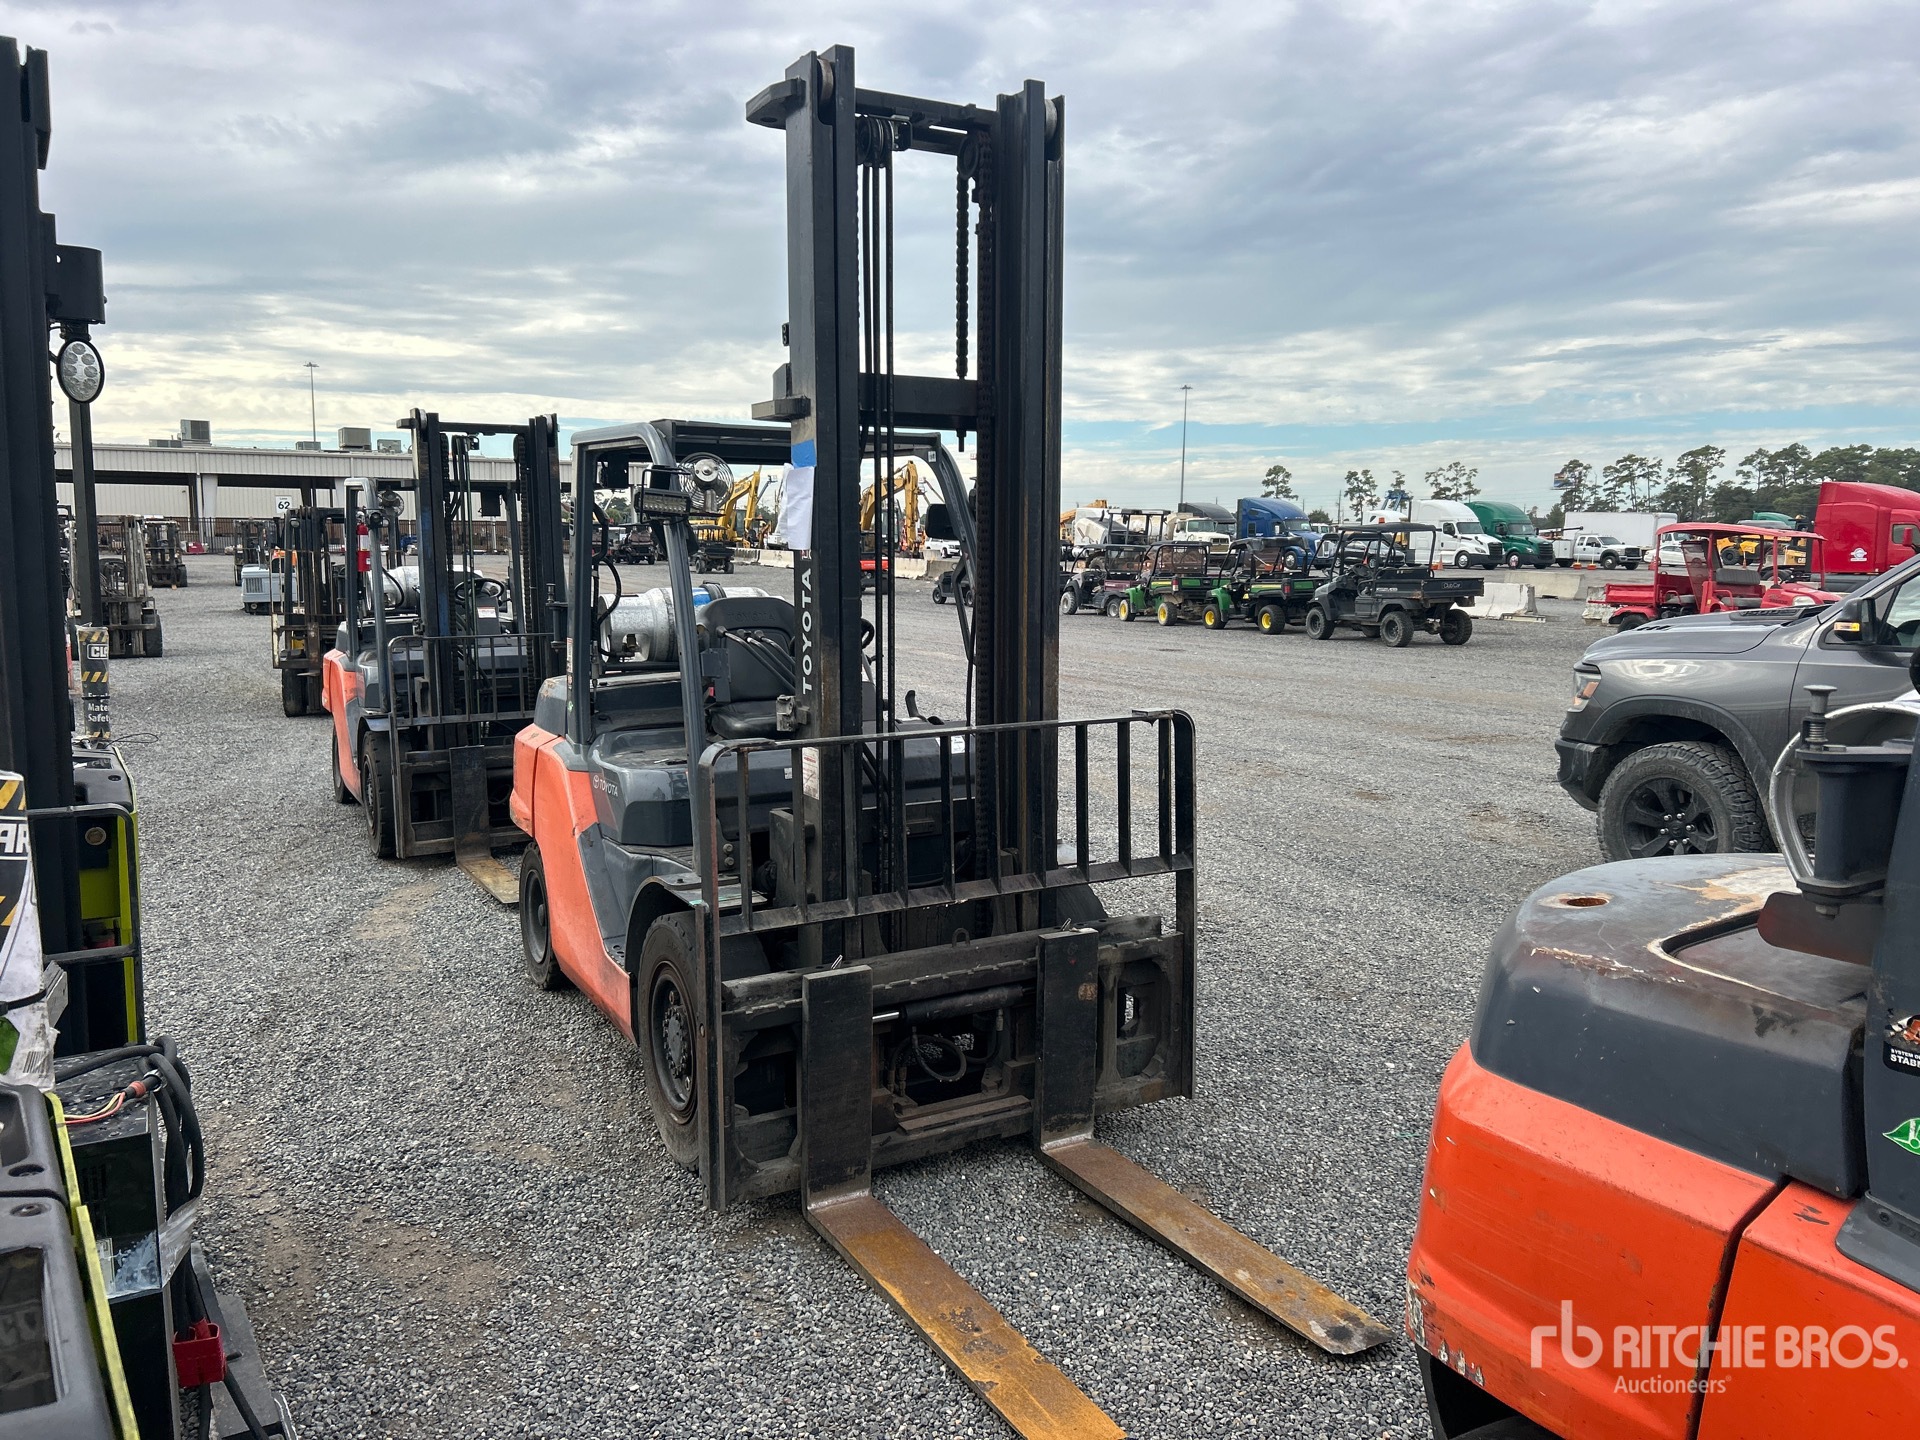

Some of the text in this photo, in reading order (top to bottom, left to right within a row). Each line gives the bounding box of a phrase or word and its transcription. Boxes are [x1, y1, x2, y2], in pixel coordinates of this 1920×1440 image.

[278, 501, 290, 510] 62
[802, 568, 812, 695] TOYOTA
[87, 702, 109, 712] Mate
[87, 713, 110, 723] Safet
[600, 779, 618, 797] TOYOTA
[1890, 1047, 1914, 1058] SYSTEM
